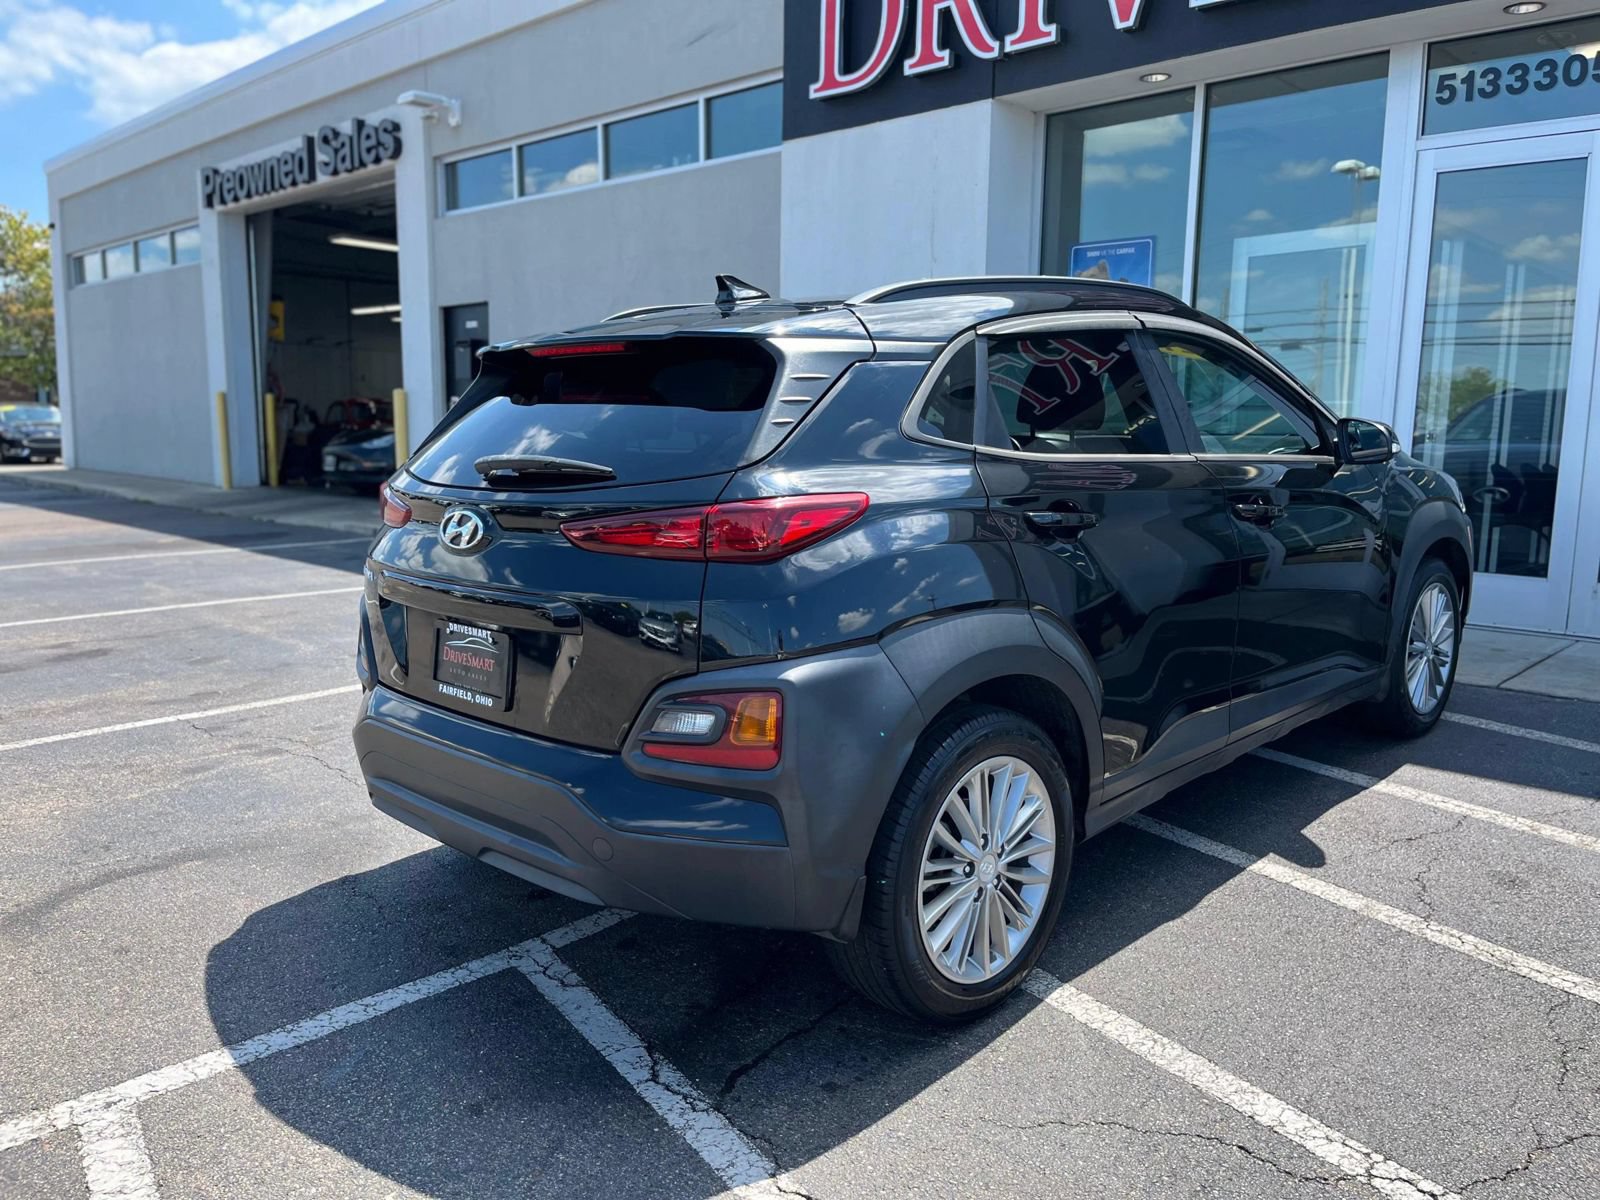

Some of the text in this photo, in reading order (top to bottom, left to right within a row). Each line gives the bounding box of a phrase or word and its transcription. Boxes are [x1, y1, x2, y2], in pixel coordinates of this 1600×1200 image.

[201, 117, 402, 208] Preowned Sales
[448, 622, 492, 640] DRIVESMART
[438, 683, 474, 703] FAIRFIELD,
[475, 695, 493, 707] OHIO
